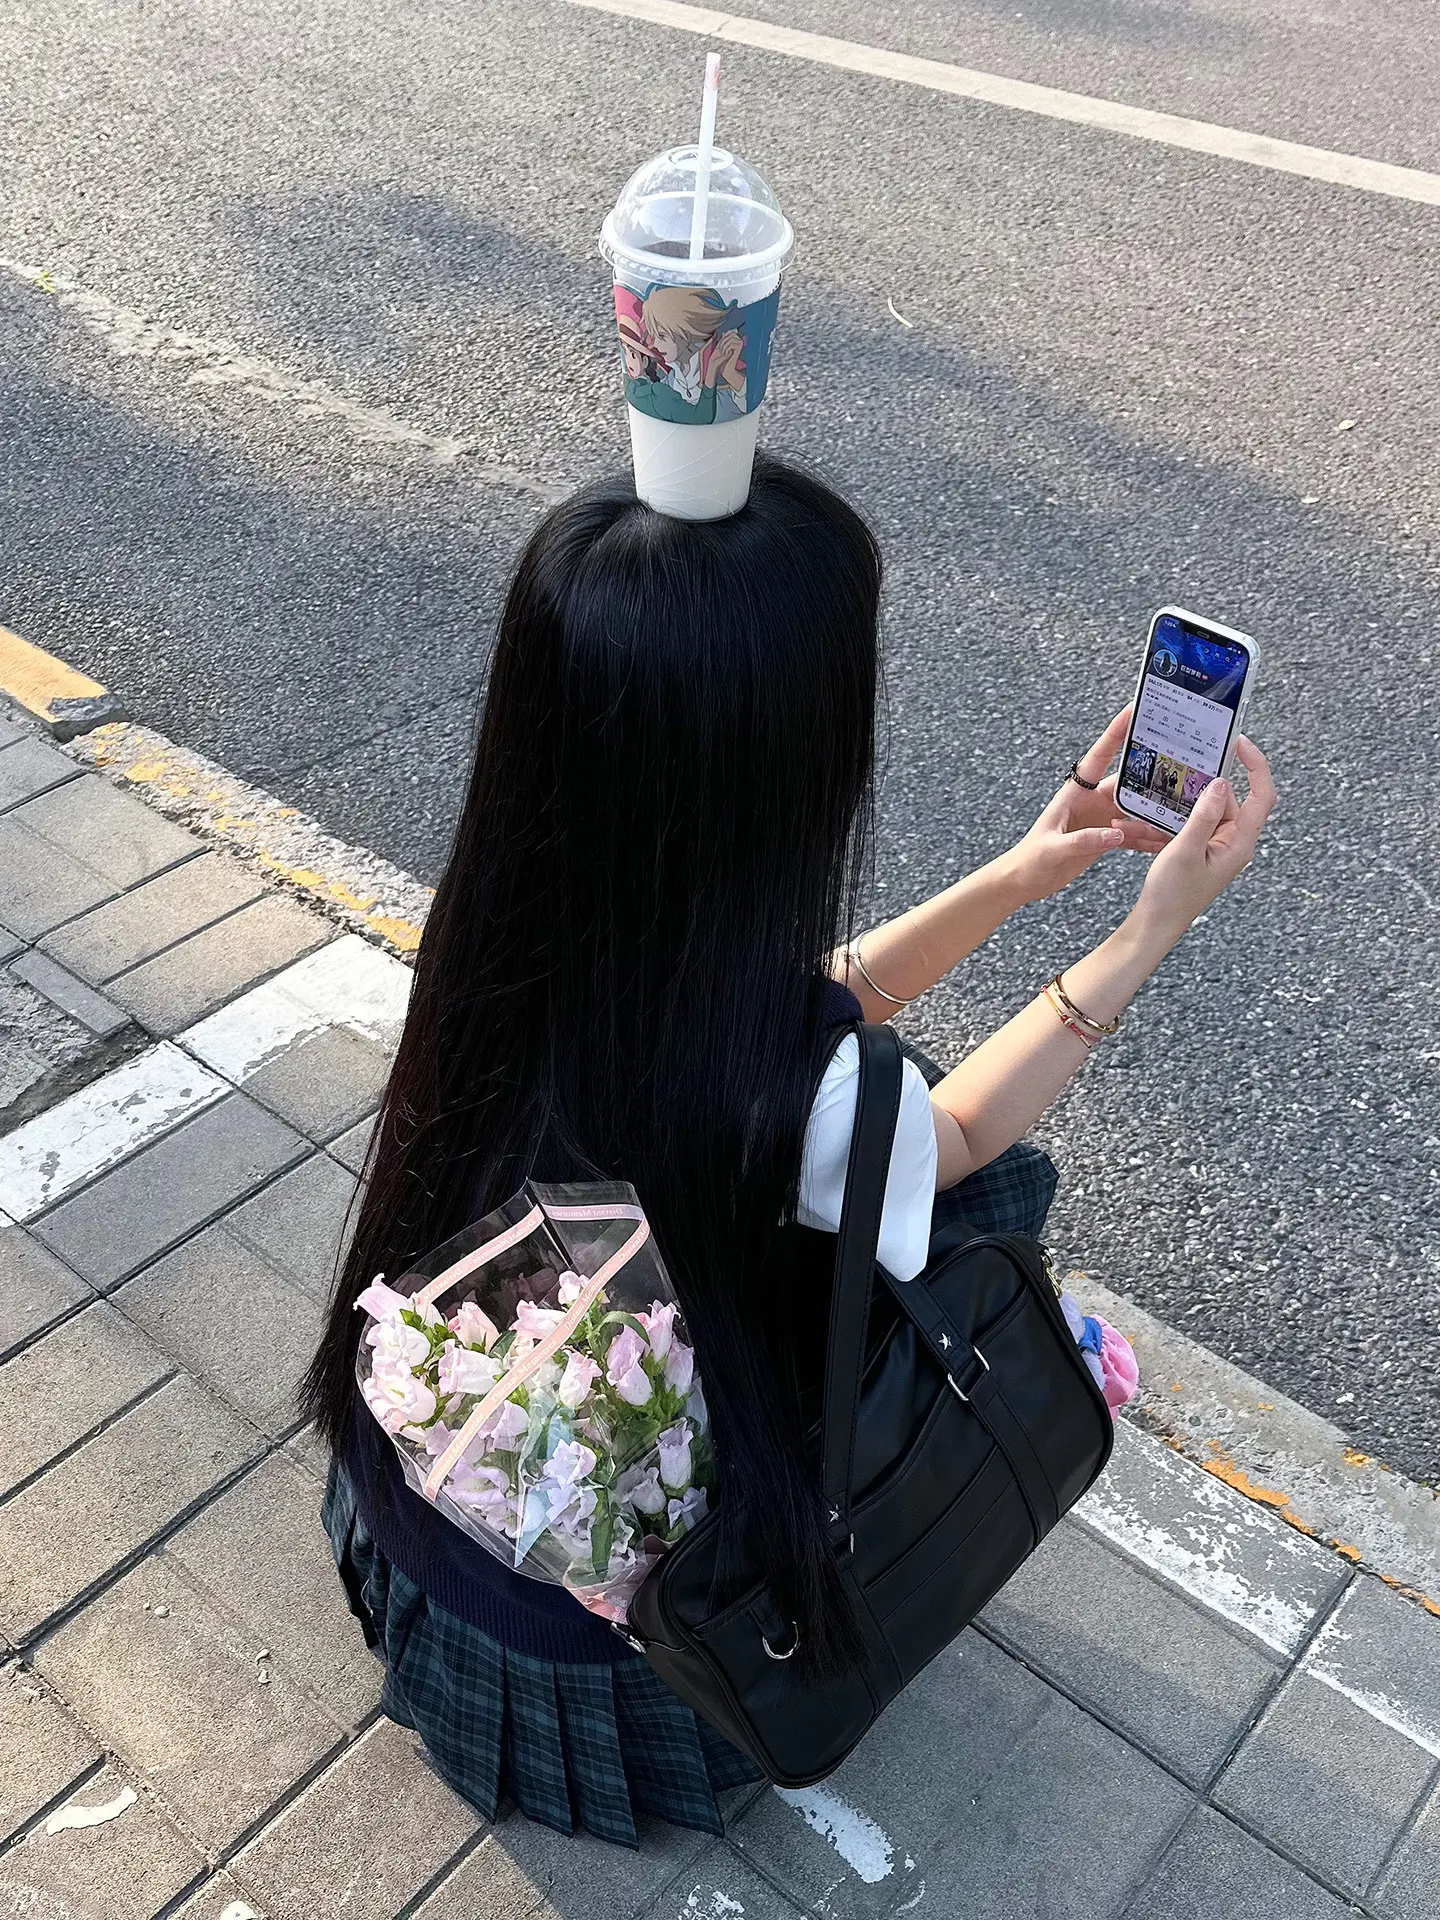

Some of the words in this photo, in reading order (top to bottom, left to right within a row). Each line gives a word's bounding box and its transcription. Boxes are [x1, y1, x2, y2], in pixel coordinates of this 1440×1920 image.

[618, 1236, 642, 1262] Distant
[563, 1303, 586, 1332] Distant
[584, 1269, 611, 1305] Memories
[491, 1373, 519, 1402] Distant
[520, 1339, 558, 1376] Memories
